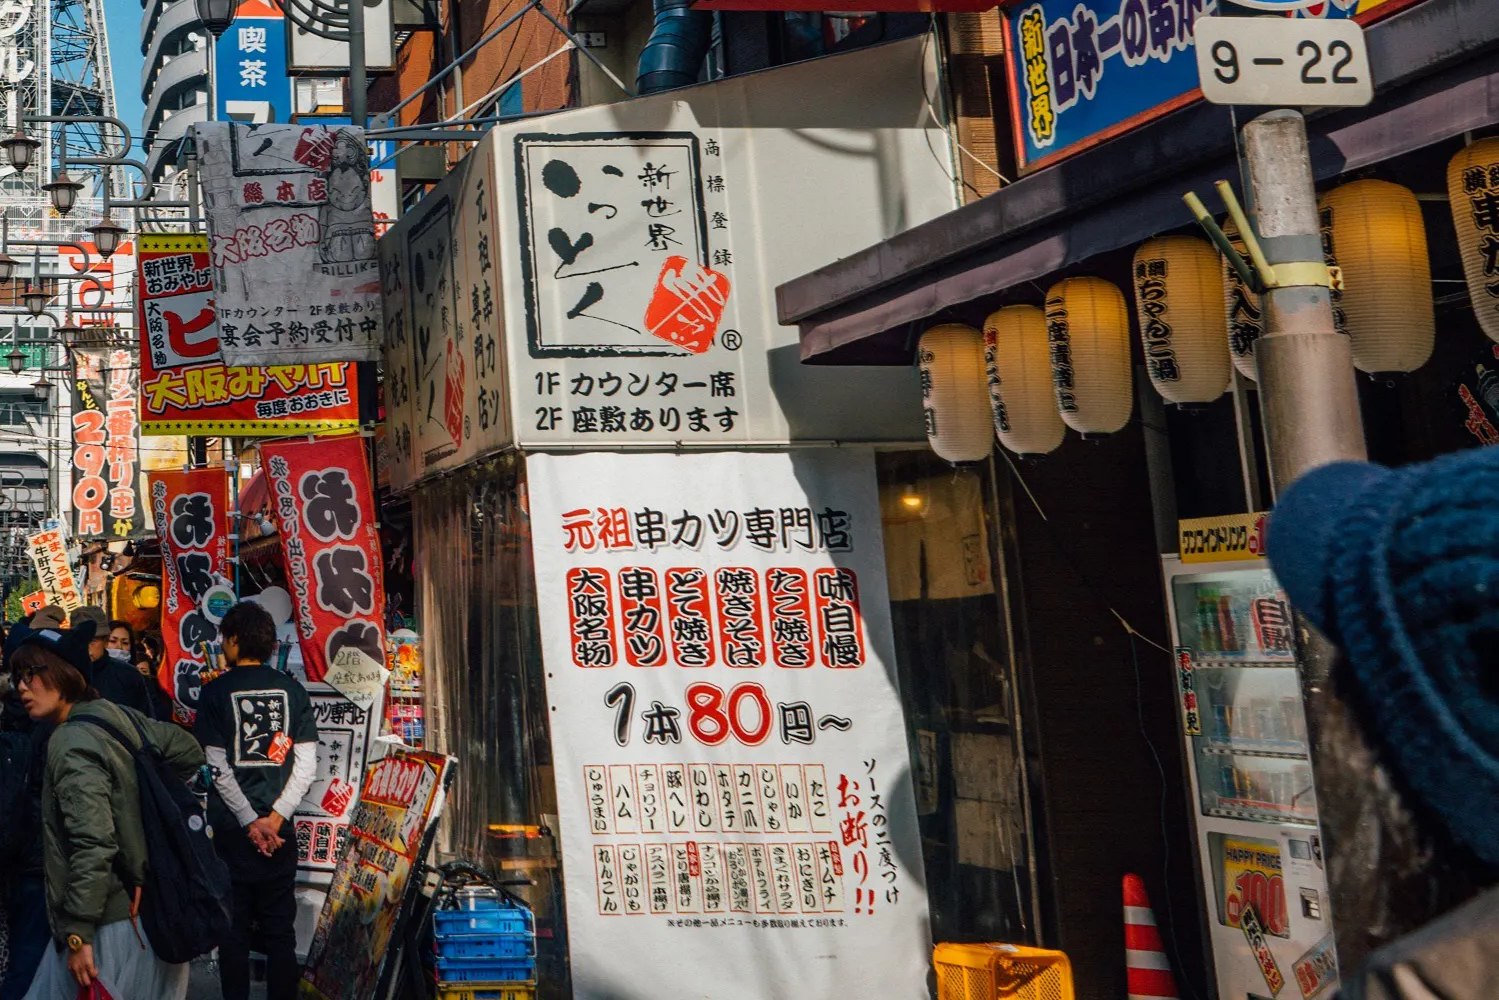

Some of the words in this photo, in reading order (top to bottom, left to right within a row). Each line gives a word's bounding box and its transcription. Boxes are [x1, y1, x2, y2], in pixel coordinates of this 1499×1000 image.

[238, 26, 267, 88] 喫茶
[1020, 4, 1056, 147] 新世界
[703, 138, 733, 266] 商標登録
[143, 254, 194, 277] 新世界
[147, 300, 168, 367] 大阪名物
[220, 315, 378, 348] 宴会予約受付中
[256, 389, 350, 419] 毎度おおきに
[570, 370, 737, 399] カウンター席
[572, 405, 740, 434] 座敷あります
[561, 505, 853, 554] 元祖串カツ専門店
[571, 568, 614, 668] 大阪名物
[620, 568, 662, 668] 串カツ
[668, 568, 710, 668] どて焼き
[717, 568, 761, 668] 焼きそば
[769, 568, 811, 668] たこ焼き
[818, 568, 862, 668] 味自慢
[615, 784, 633, 819] ハム
[693, 769, 713, 828] いわし
[717, 770, 737, 829] ホタテ
[762, 769, 781, 830] ししゃも
[785, 783, 803, 820] いか
[810, 780, 827, 818] たこ
[314, 822, 331, 862] 味自慢
[597, 847, 618, 912] れんこん
[797, 848, 817, 908] おにぎり
[819, 847, 836, 904] キムチ
